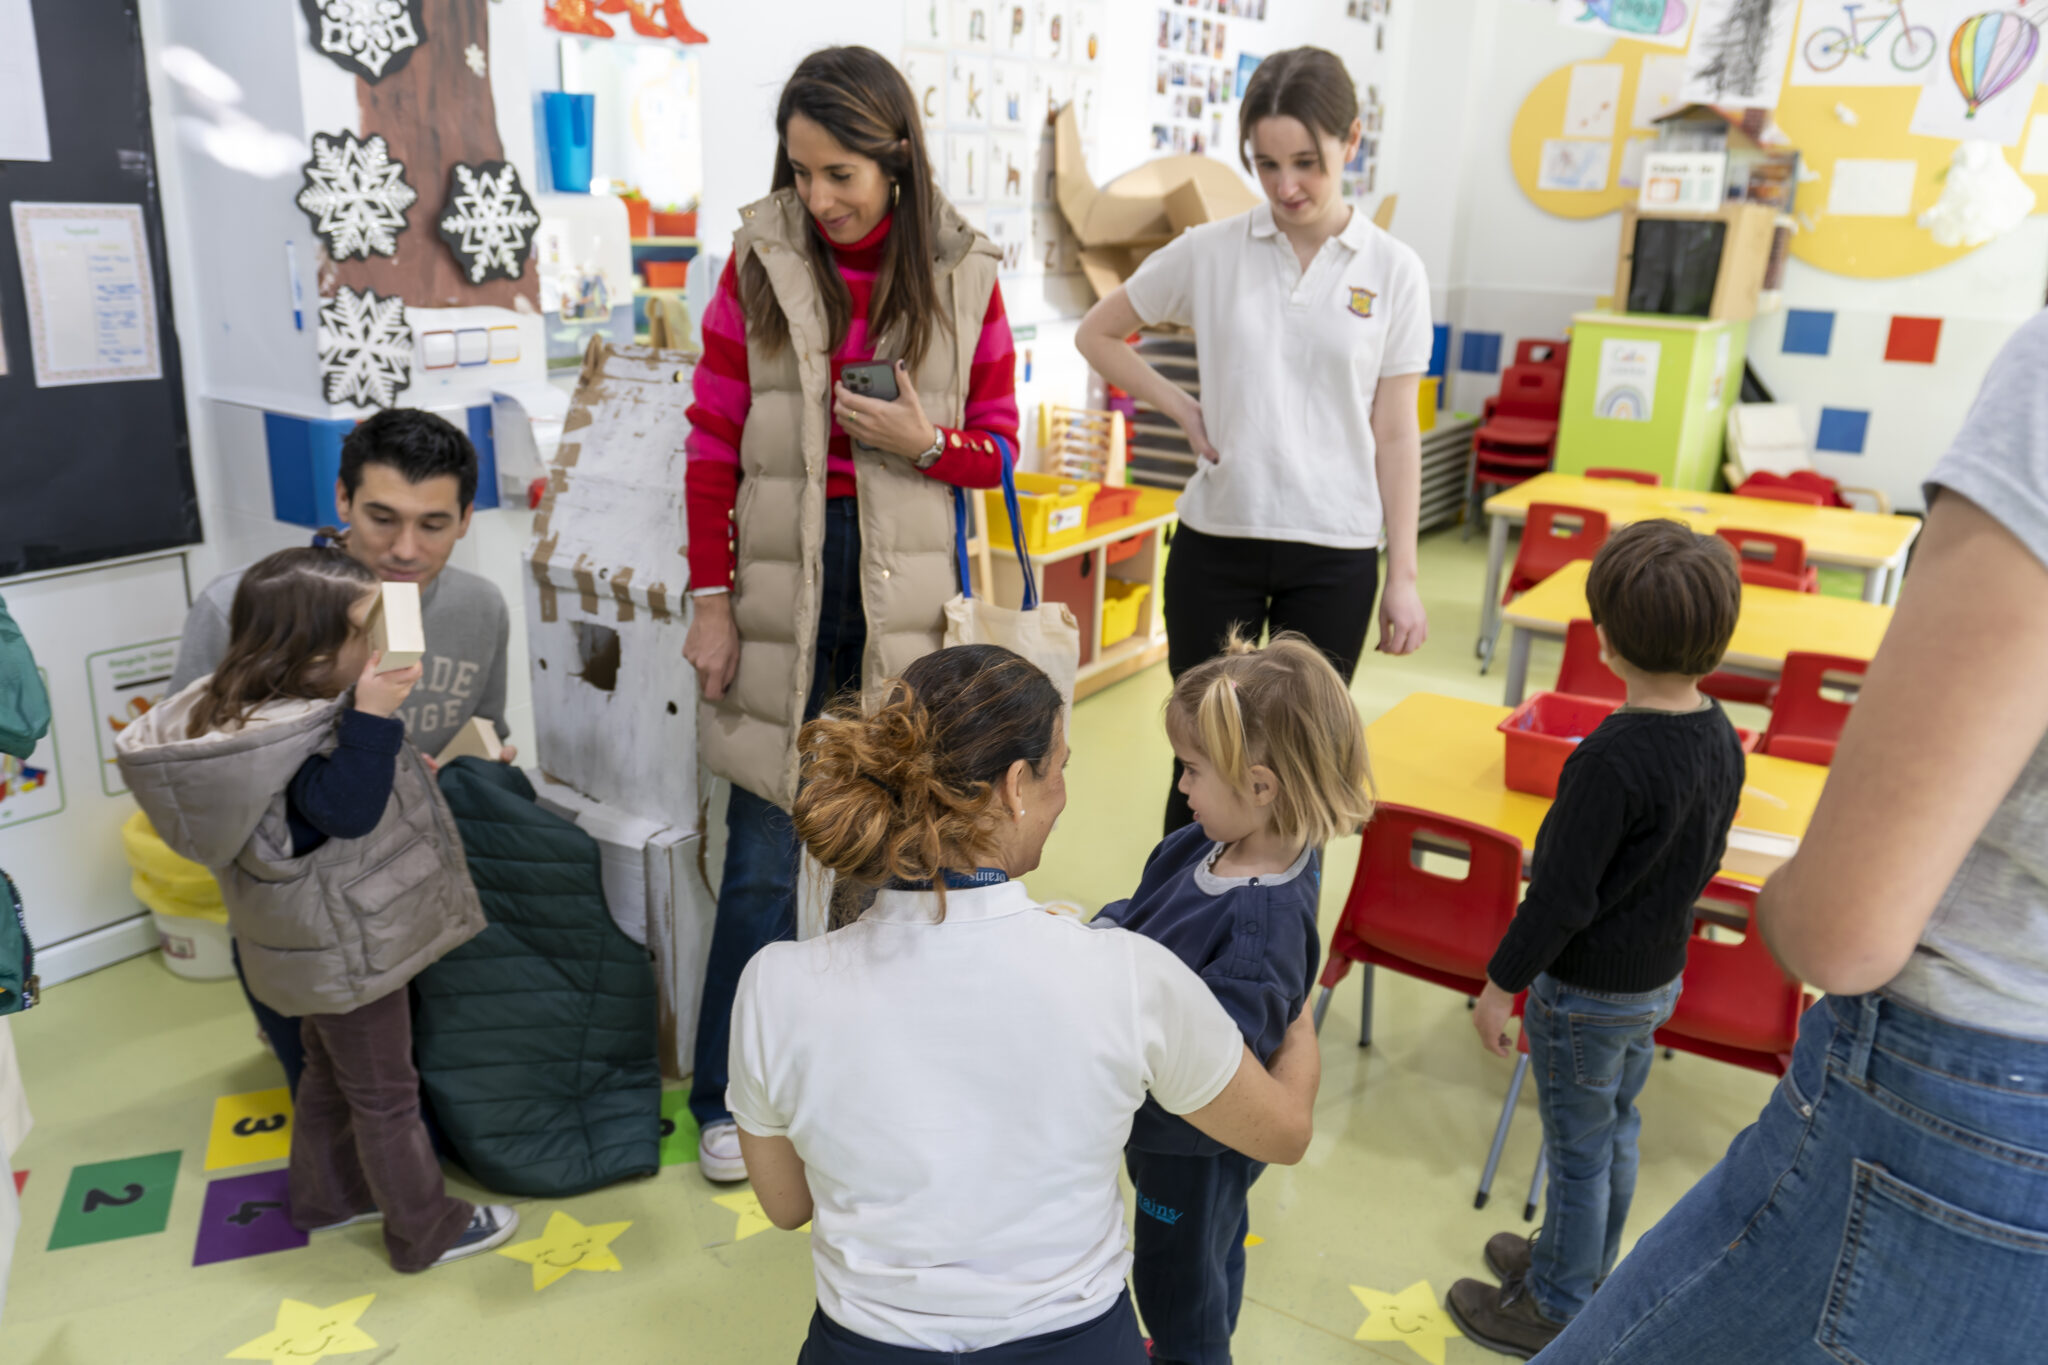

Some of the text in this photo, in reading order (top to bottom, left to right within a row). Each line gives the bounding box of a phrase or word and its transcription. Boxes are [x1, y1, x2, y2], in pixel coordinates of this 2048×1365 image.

[416, 656, 479, 699] DE
[231, 1113, 287, 1137] 3
[82, 1182, 145, 1214] 2
[226, 1201, 284, 1226] 4
